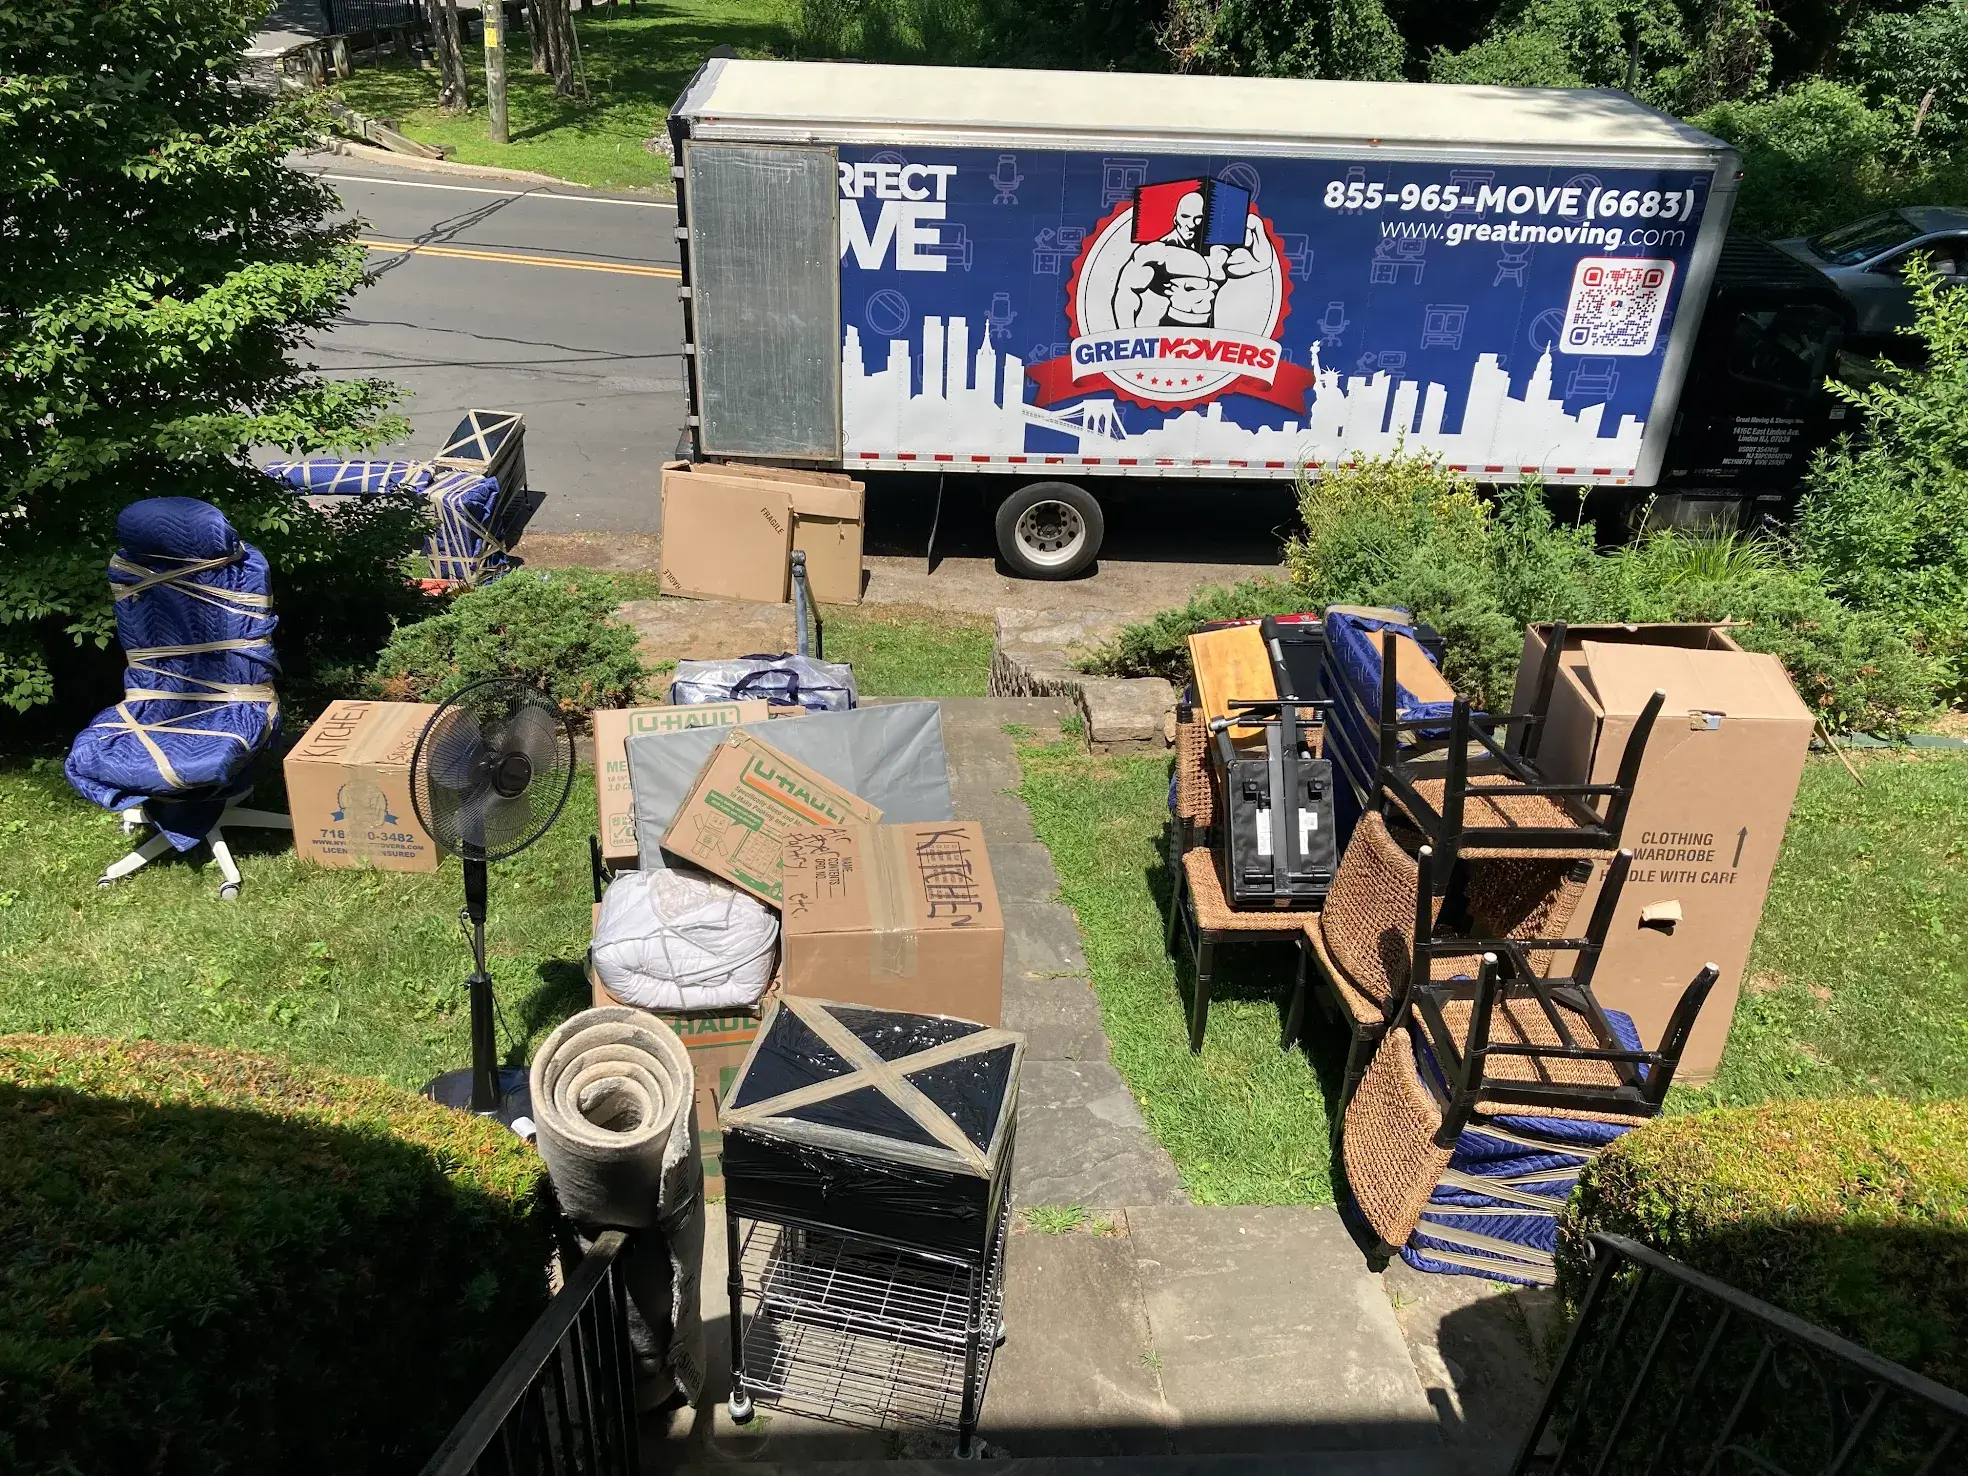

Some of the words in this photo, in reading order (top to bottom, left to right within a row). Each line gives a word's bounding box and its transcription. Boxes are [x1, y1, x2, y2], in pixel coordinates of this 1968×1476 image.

[838, 162, 957, 200] RFECT
[1323, 180, 1583, 216] 855-965-MOVE
[1587, 187, 1694, 222] (6683)
[840, 199, 947, 272] VE
[1381, 220, 1685, 251] www.greatmoving.com
[1752, 427, 1766, 436] East
[760, 507, 785, 536] FRAGILE
[662, 568, 682, 590] RAGILE
[298, 702, 372, 757] KITCHEN
[637, 711, 733, 732] U-HAUL
[734, 785, 767, 808] Specifically
[766, 803, 784, 816] Sized
[736, 795, 753, 808] Make
[751, 805, 776, 823] Packing
[1641, 831, 1714, 846] CLOTHING
[841, 856, 853, 873] NAME
[1632, 848, 1716, 862] WARDROBE
[828, 857, 841, 886] CONTENTS
[916, 828, 983, 927] KITCHEN
[1599, 869, 1657, 883] HDLE
[1660, 870, 1697, 883] WITH
